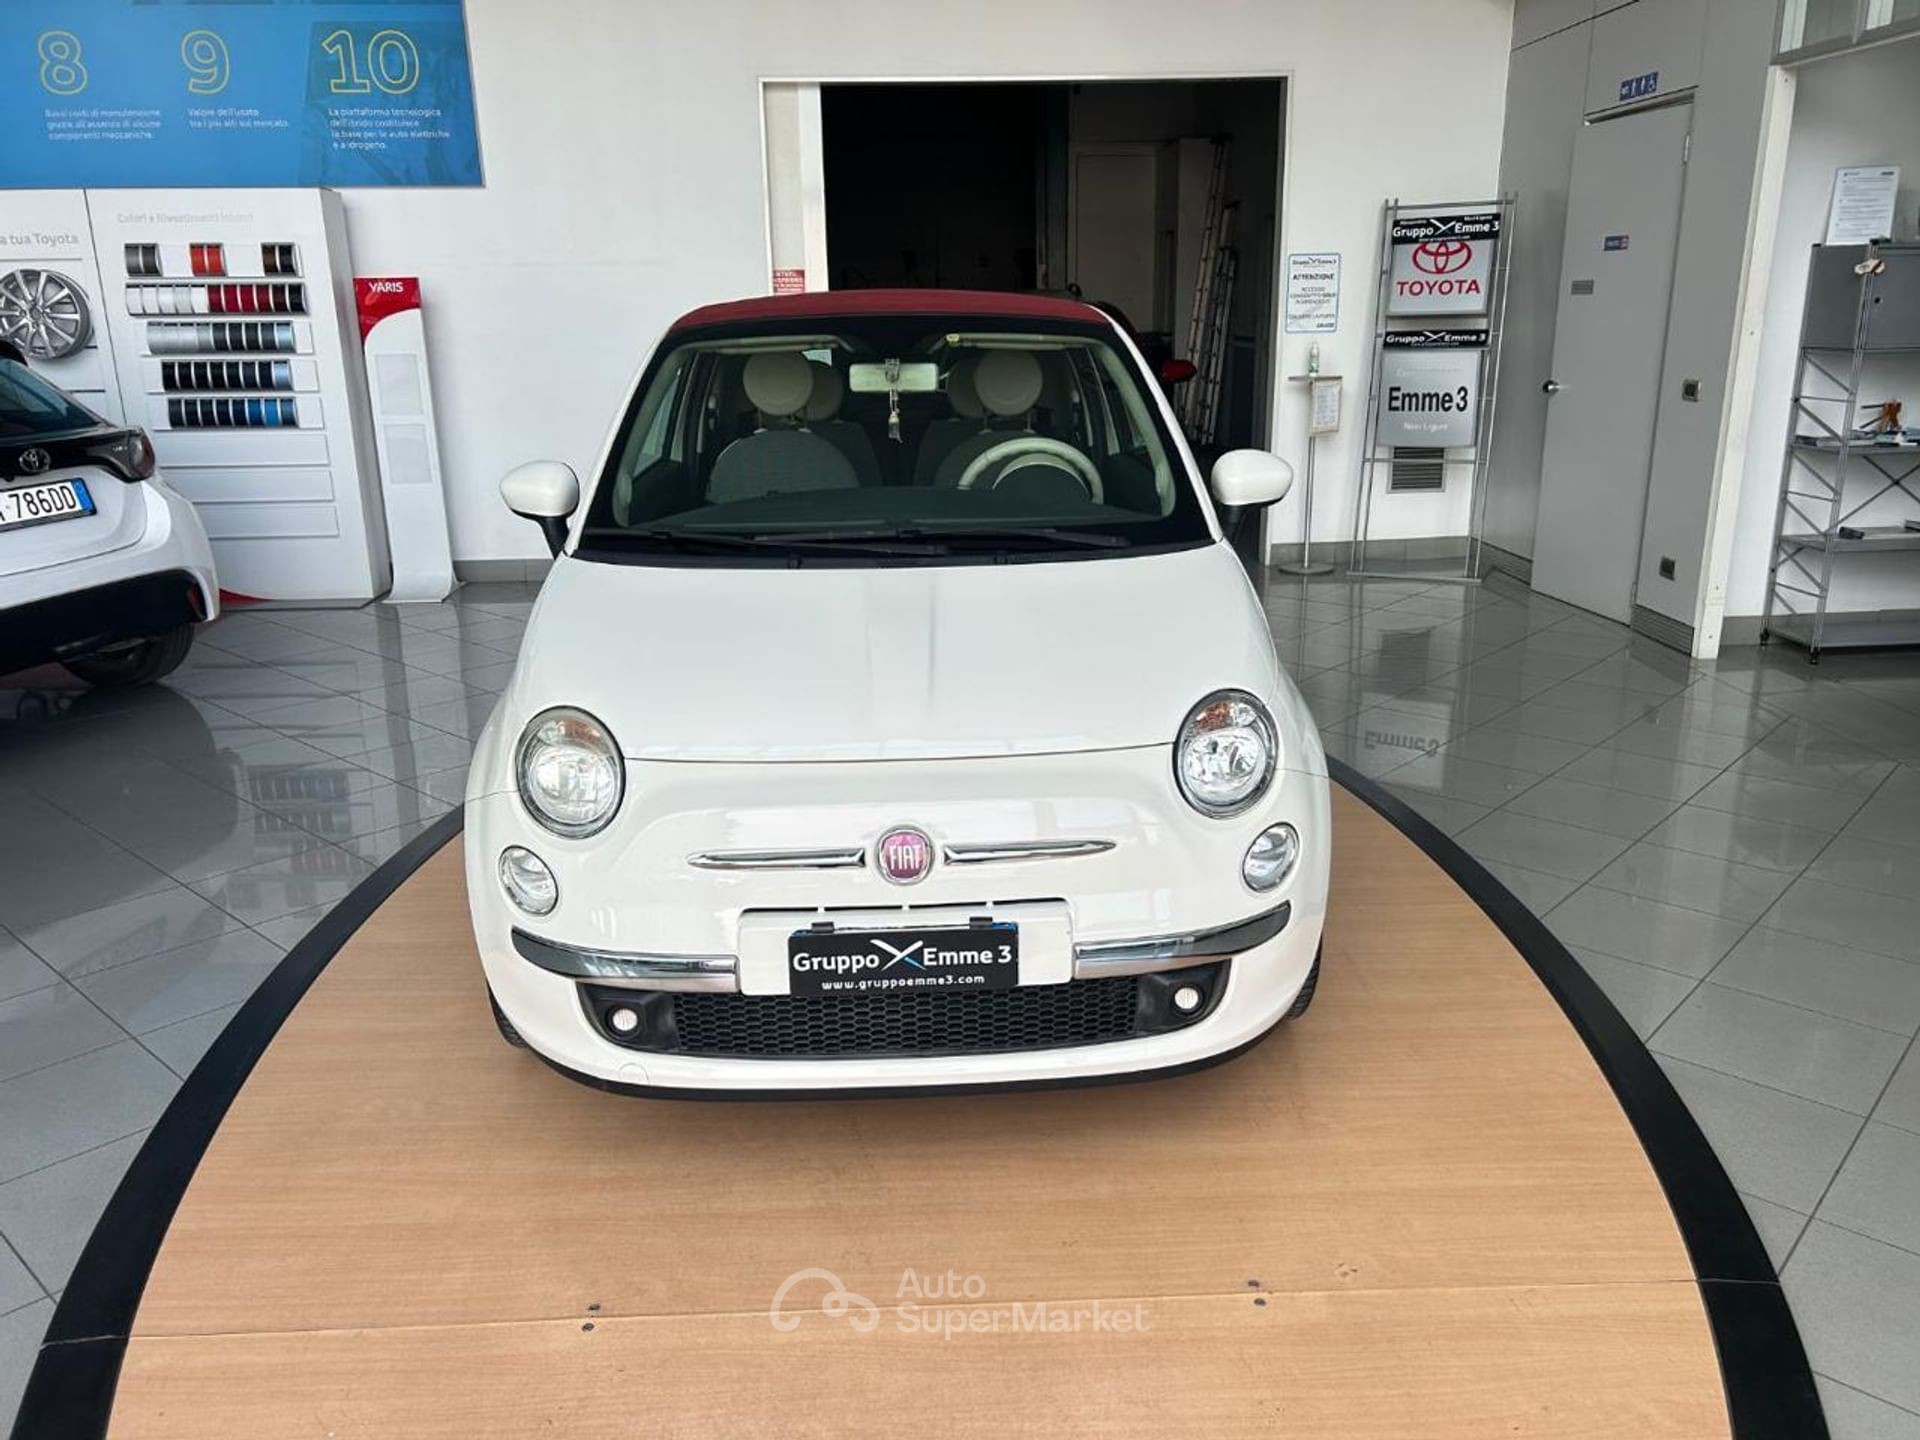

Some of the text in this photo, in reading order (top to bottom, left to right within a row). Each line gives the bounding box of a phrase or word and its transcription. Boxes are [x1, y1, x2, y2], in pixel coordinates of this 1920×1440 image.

[37, 30, 88, 96] 8
[180, 29, 230, 95] 9
[321, 28, 421, 94] 10
[10, 234, 32, 245] tua
[35, 232, 79, 249] Toyota
[1392, 220, 1500, 239] Gruppo Emme 3
[368, 281, 404, 293] YARIS
[1293, 273, 1334, 281] ATTENZIONE
[1396, 279, 1481, 297] TOYOTA
[1386, 330, 1487, 344] Gruppo Emme 3
[1387, 386, 1468, 413] Emme 3
[8, 485, 77, 519] 786DD
[889, 844, 921, 870] FIAT
[793, 945, 1012, 974] Gruppo Emme 3
[821, 974, 985, 990] www.gruppoemme3.com
